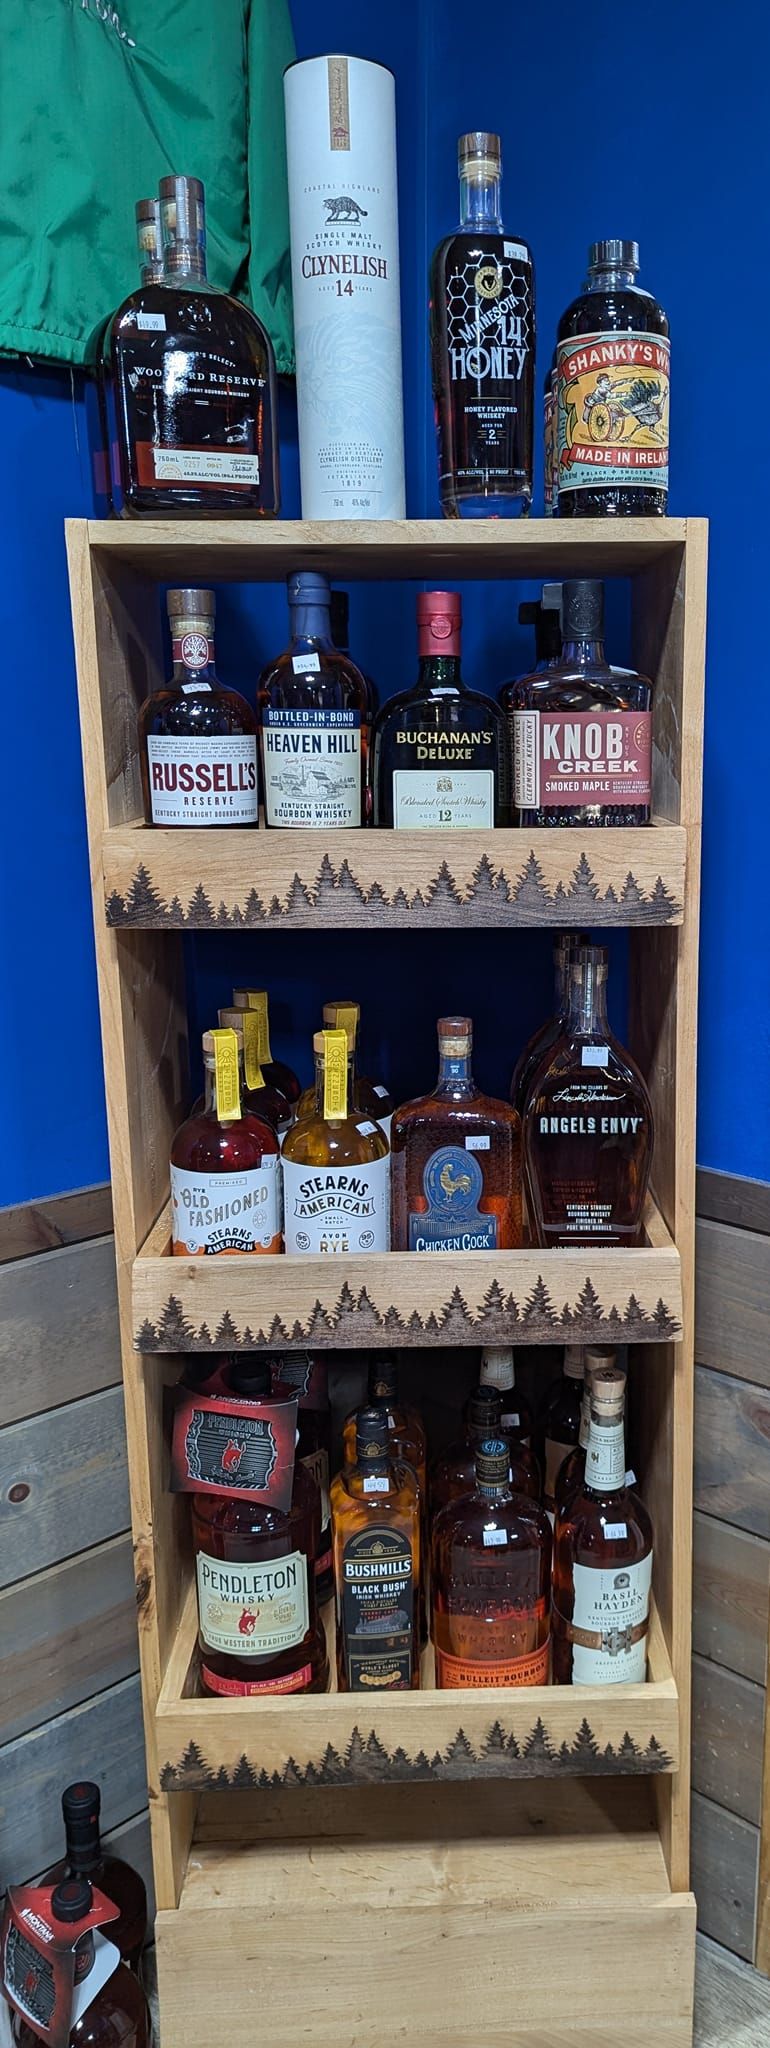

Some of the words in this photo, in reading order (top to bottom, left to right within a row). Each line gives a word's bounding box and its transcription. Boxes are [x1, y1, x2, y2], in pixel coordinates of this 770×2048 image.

[351, 232, 372, 240] MALT
[306, 240, 340, 250] SCOTCH
[347, 240, 382, 250] WHISKY
[302, 254, 388, 280] CLYNELISH
[336, 280, 354, 296] 14
[458, 294, 519, 343] MINNESOTA
[497, 316, 522, 346] 14
[209, 354, 233, 367] SELECT
[451, 347, 527, 380] HONEY
[568, 344, 653, 376] SHANKY'S
[133, 366, 205, 381] WOORD
[209, 373, 265, 387] RESERVE
[488, 429, 496, 439] 2
[576, 448, 612, 462] MADE
[617, 452, 630, 463] IN
[269, 711, 354, 722] BOTTLED-IN-BOND
[266, 733, 322, 753] HEAVEN
[327, 734, 358, 753] HILL
[396, 731, 492, 744] BUCHANAN'S
[526, 719, 534, 758] KENTUCKY
[543, 723, 623, 760] KNOB
[557, 760, 638, 773] CREEK
[152, 762, 256, 792] RUSSELL'S
[545, 781, 579, 792] SMOKED
[582, 781, 610, 791] MAPLE
[184, 796, 234, 806] RESERVE
[400, 796, 434, 806] Blended
[436, 796, 461, 807] Scotch
[461, 797, 487, 808] Whisky
[155, 809, 180, 817] KENTUCKY
[182, 810, 212, 818] STRAIGHT
[274, 809, 312, 818] BOURBON
[315, 809, 352, 818] WHISKEY
[438, 810, 452, 821] 12
[601, 1117, 639, 1134] ENVY
[300, 1176, 369, 1198] STEARNS
[180, 1188, 209, 1209] OLD
[300, 1197, 370, 1215] AMERICAN
[189, 1186, 269, 1227] FASHIONED
[207, 1228, 253, 1243] STEARNS
[416, 1237, 460, 1252] CHICKEN
[462, 1234, 490, 1251] COCK
[207, 1239, 254, 1254] AMERICAN
[320, 1240, 349, 1252] RYE
[207, 1413, 264, 1436] PENDLETON
[346, 1560, 411, 1576] BUSHMILLS
[202, 1563, 297, 1594] PENDLETON
[352, 1585, 379, 1594] BLACK
[383, 1582, 405, 1592] BUSH
[602, 1588, 638, 1601] BASIL
[220, 1593, 275, 1604] WHISKY
[594, 1595, 643, 1610] HAYDEN
[224, 1639, 255, 1647] WESTERN
[259, 1634, 296, 1646] TRADITION
[460, 1674, 500, 1683] BULLEIT
[504, 1662, 545, 1681] BOURBON
[26, 1912, 55, 1942] MONTANA
